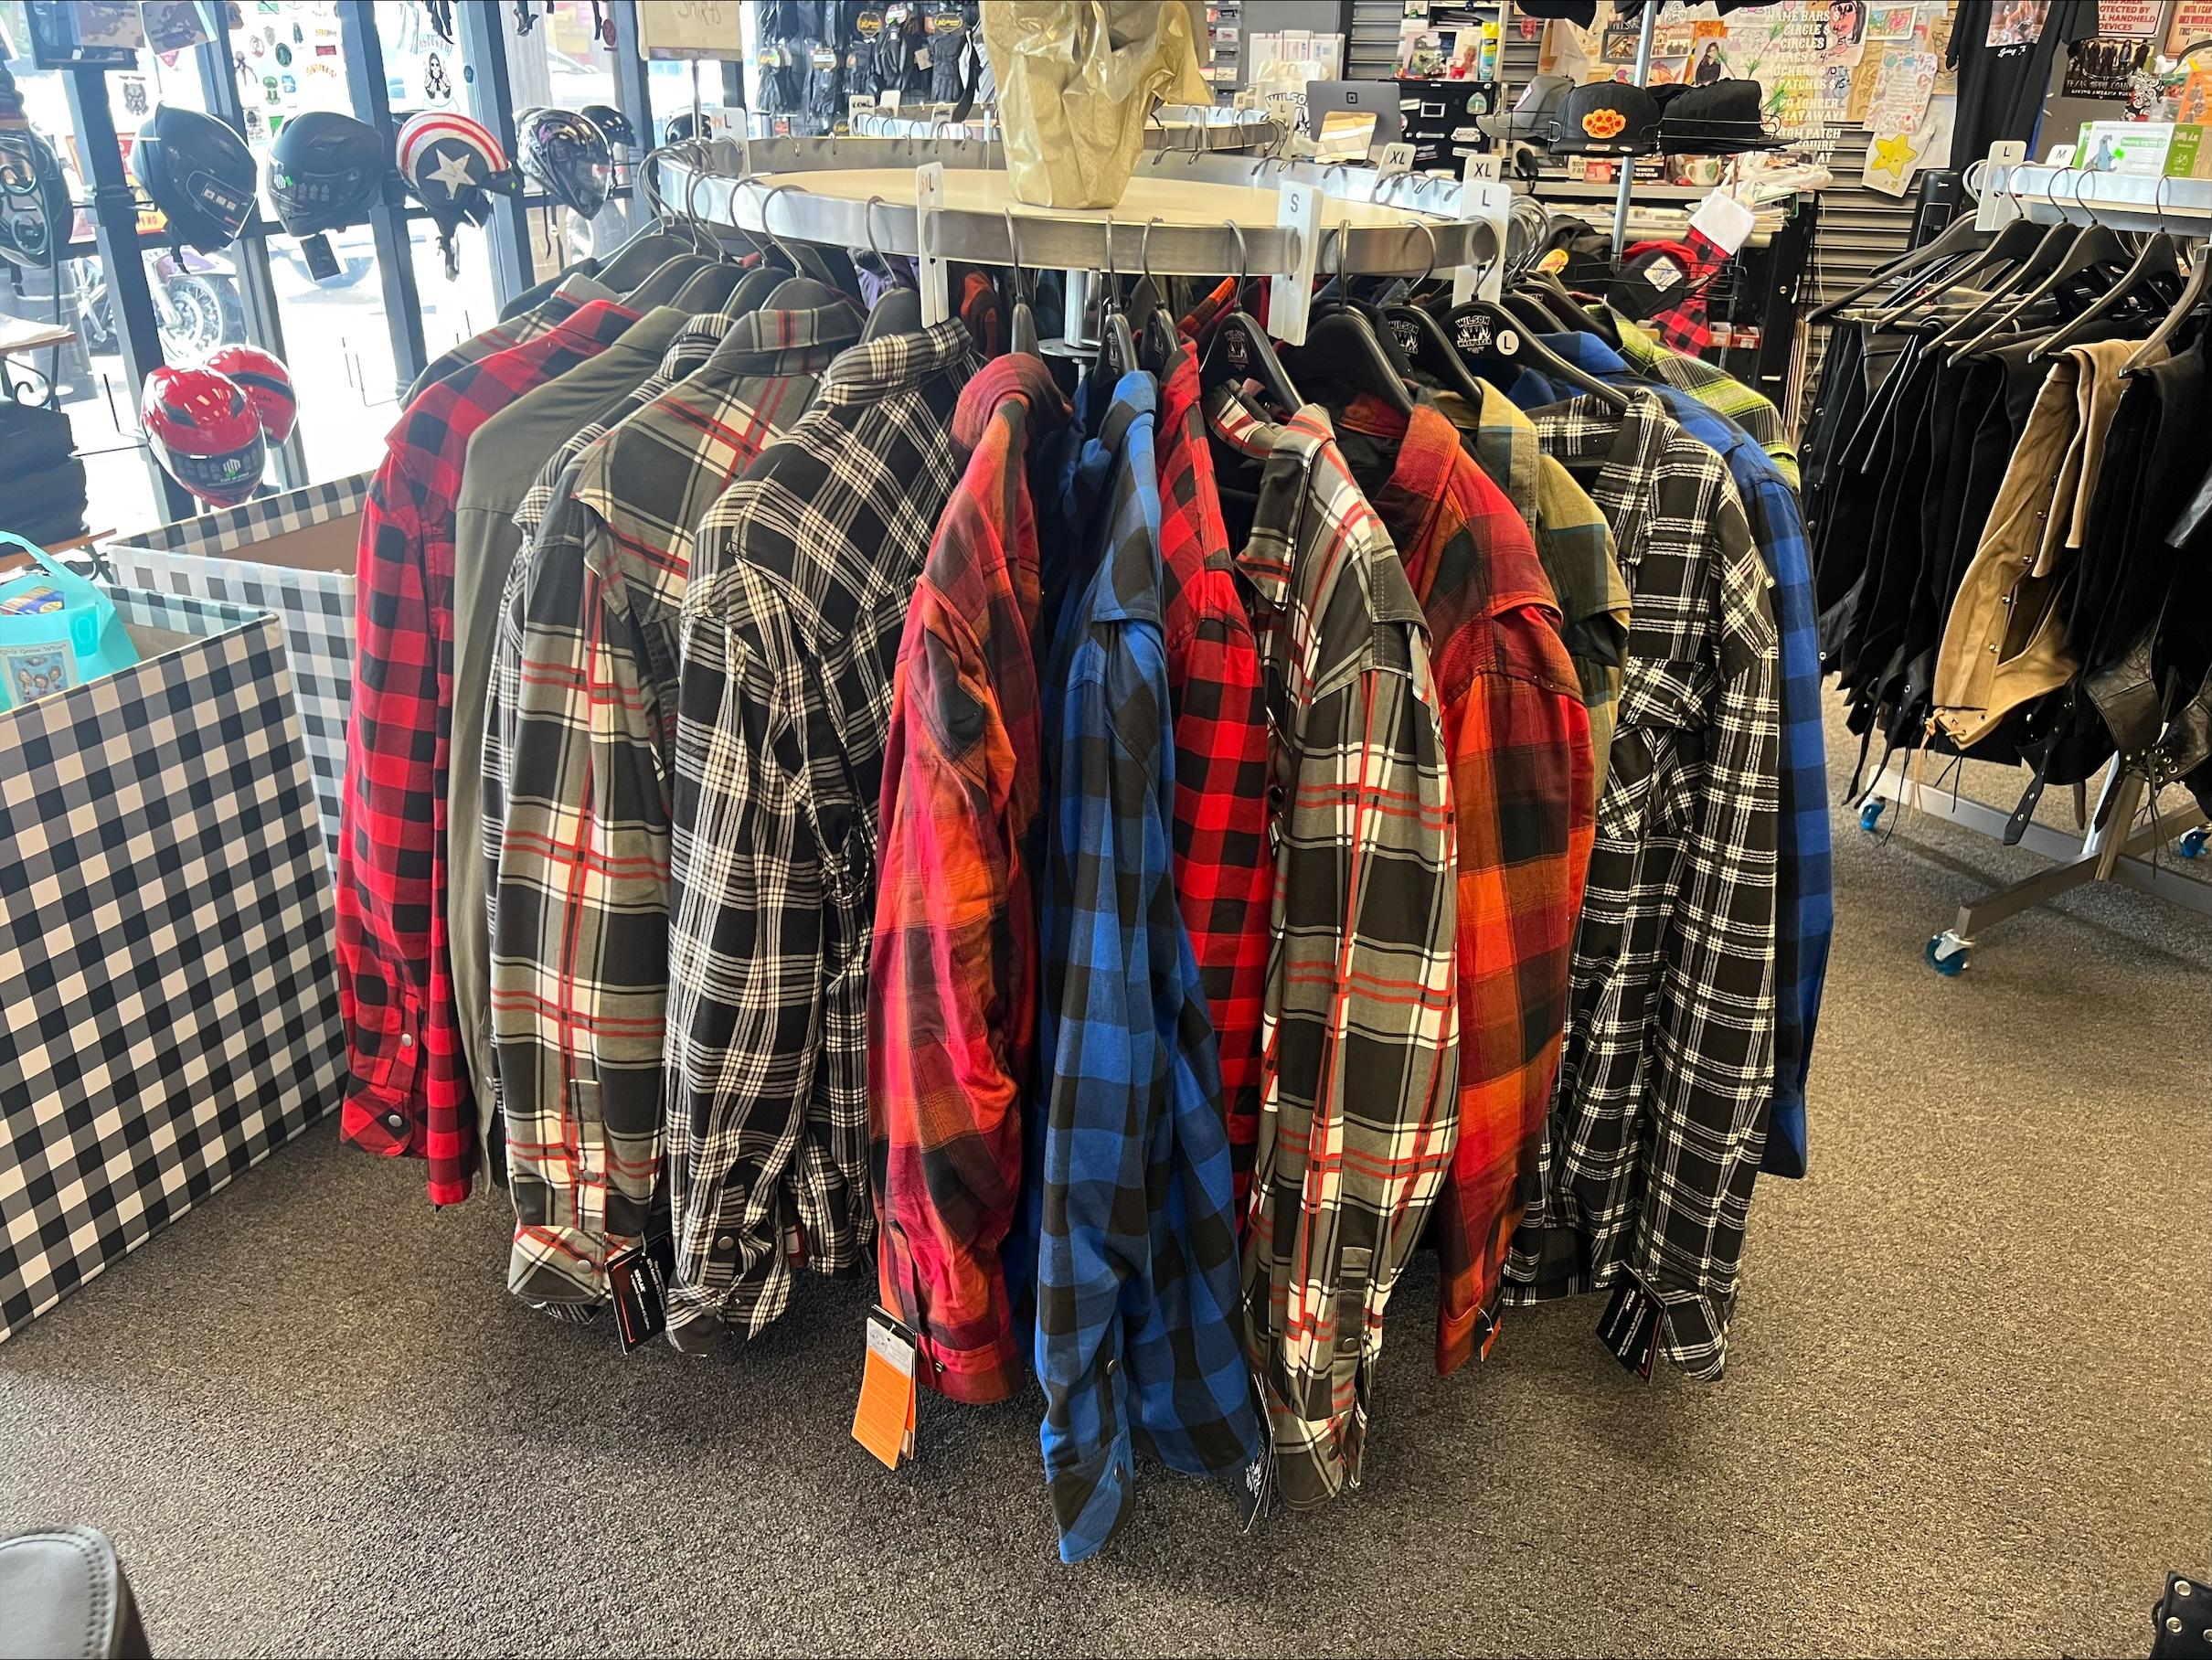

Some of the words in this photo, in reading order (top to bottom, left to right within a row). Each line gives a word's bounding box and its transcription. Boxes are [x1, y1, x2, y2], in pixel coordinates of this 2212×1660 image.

[1801, 11, 1830, 22] BARS
[2099, 6, 2137, 15] OTECTED
[2109, 15, 2156, 24] HANDHELD
[1783, 24, 1822, 36] CIRCLE
[1780, 37, 1825, 49] CIRCLES
[1265, 92, 1309, 108] WILSO
[1796, 98, 1839, 109] LONGER
[1807, 128, 1843, 139] PATCH
[2004, 146, 2010, 157] L
[2056, 149, 2067, 160] M
[1389, 151, 1405, 165] XL
[1473, 163, 1492, 177] XL
[1291, 193, 1299, 213] S
[1482, 189, 1491, 208] L
[1455, 314, 1491, 328] WILSON
[1504, 335, 1512, 349] L
